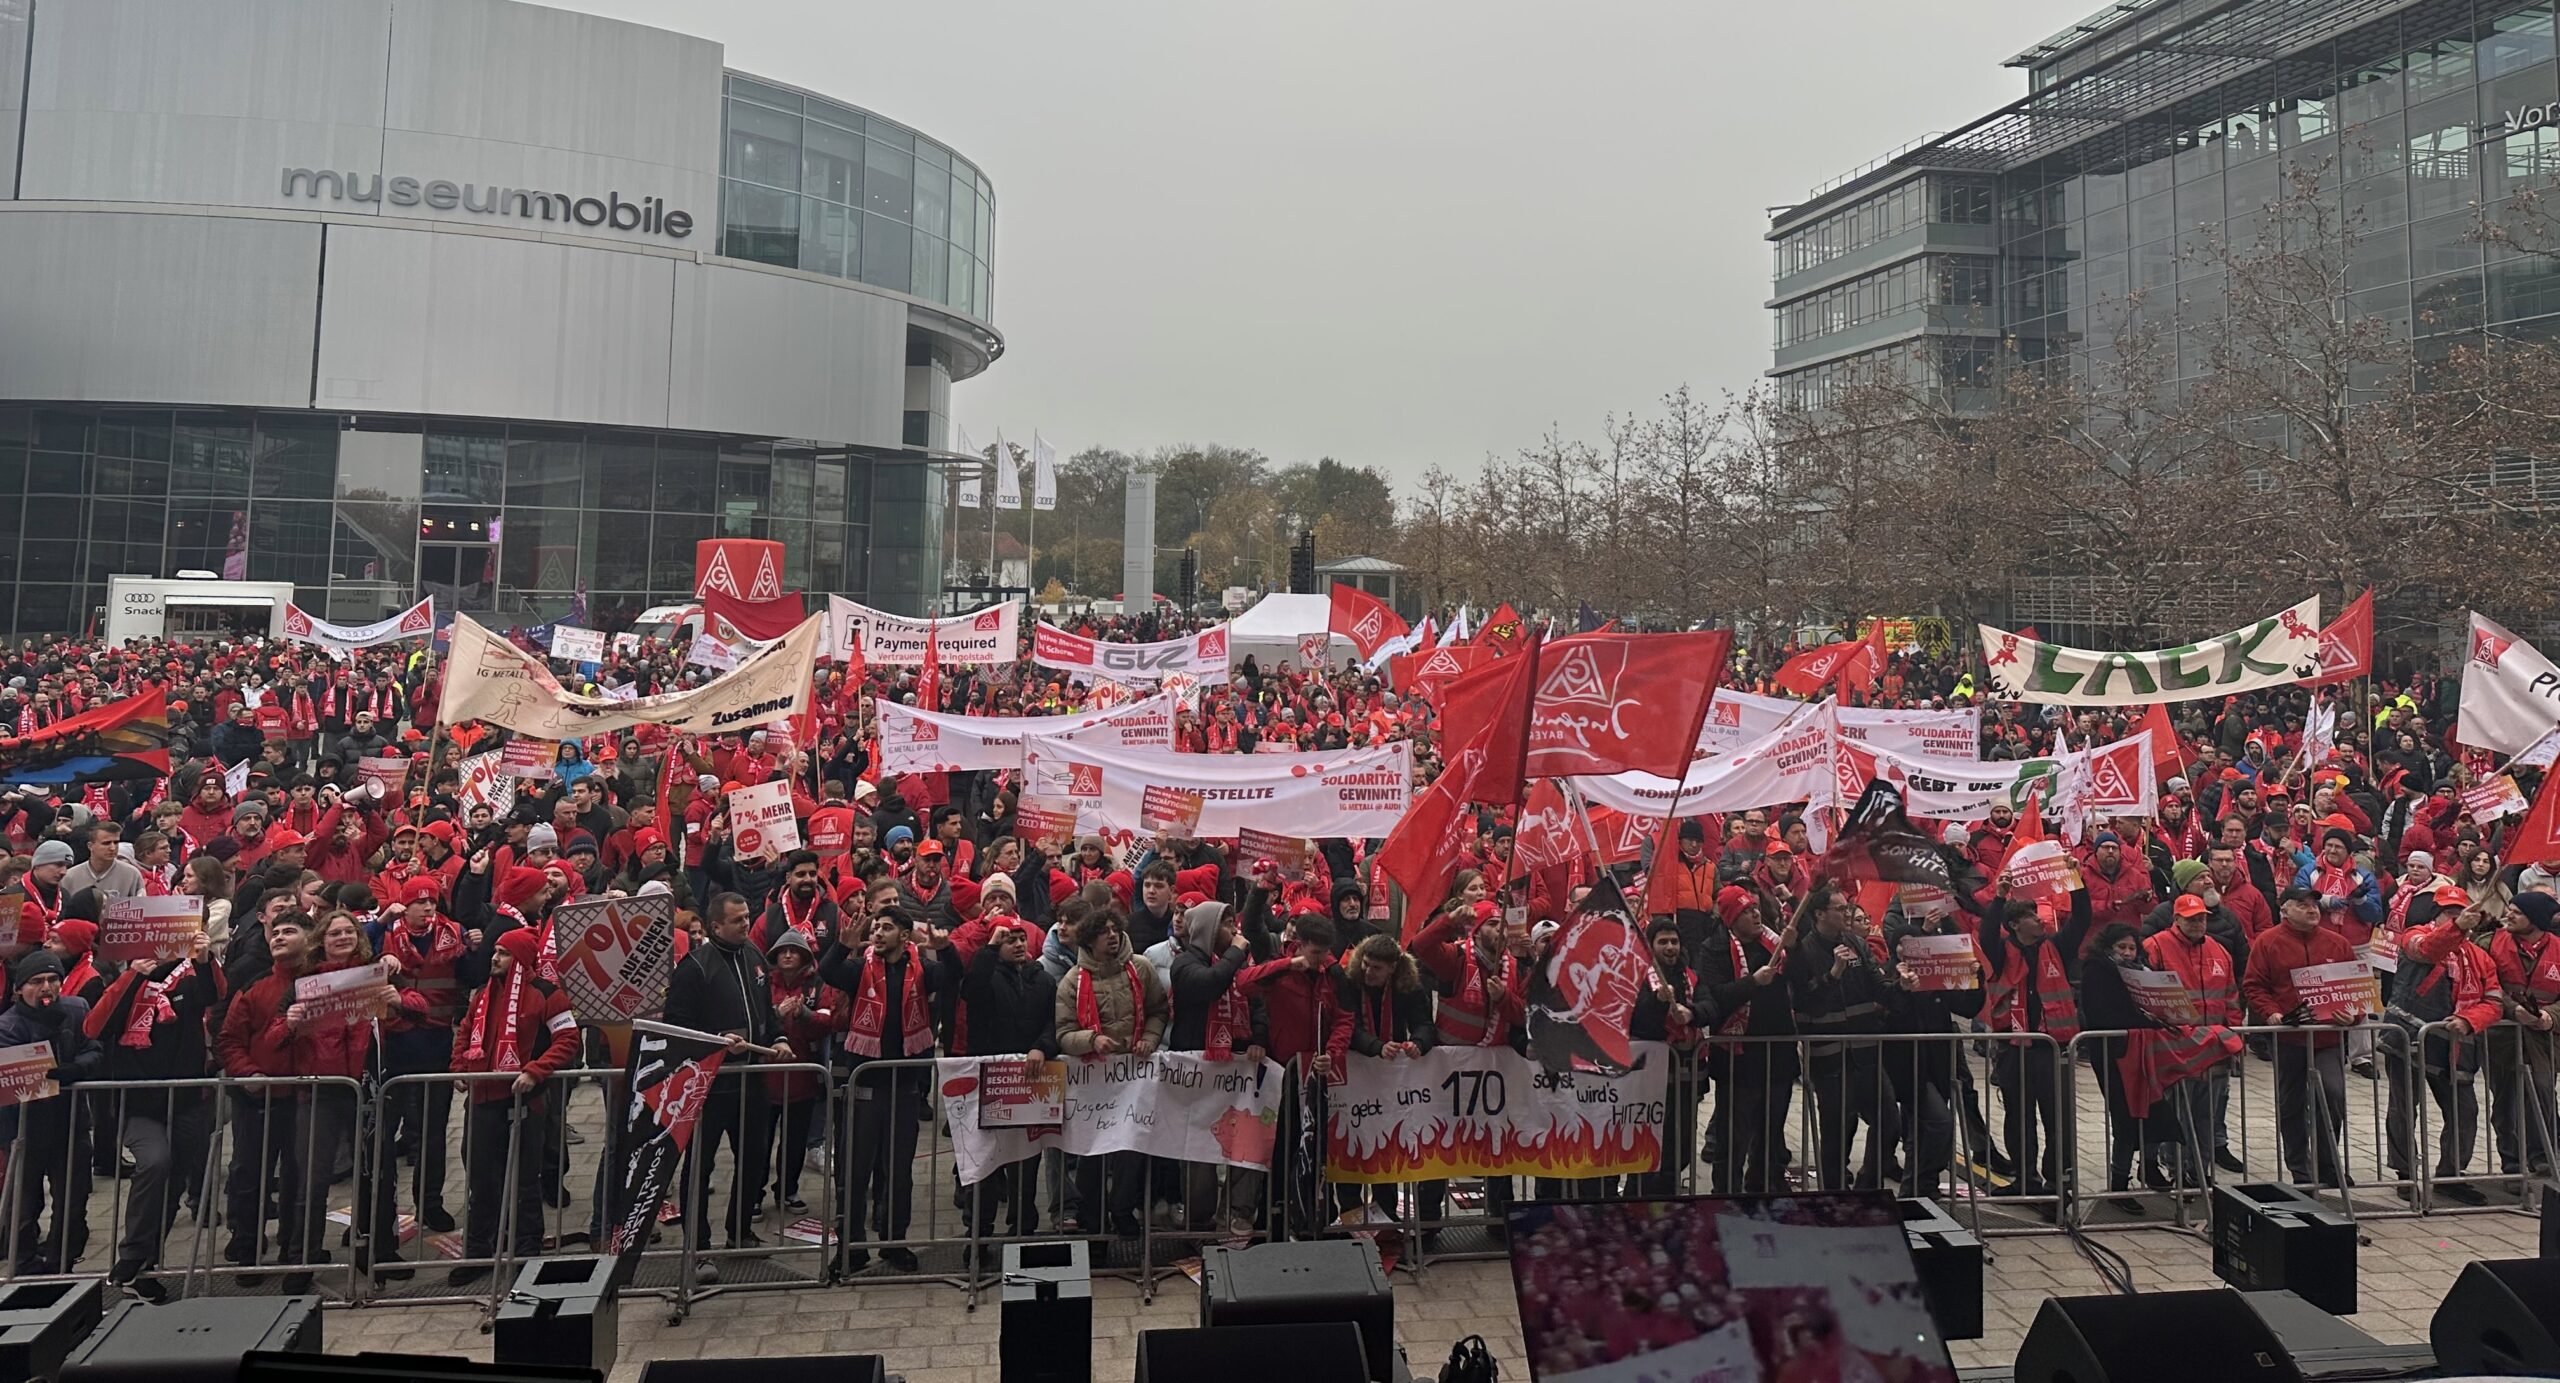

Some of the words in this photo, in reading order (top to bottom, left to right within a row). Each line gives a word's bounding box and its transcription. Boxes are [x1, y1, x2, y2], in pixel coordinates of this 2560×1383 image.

[124, 606, 163, 615] Snack
[876, 620, 913, 632] HTTP
[874, 637, 928, 652] Paymen
[938, 637, 997, 652] required
[949, 652, 994, 662] Ingolstadt
[1102, 645, 1189, 671] GVZ
[2023, 617, 2289, 696] LACK
[477, 667, 489, 678] IG
[492, 670, 525, 680] METALL
[1107, 714, 1168, 728] SOLIDARITÄT
[1121, 728, 1168, 738] GEWINNT!
[1726, 728, 1740, 736] AUDI
[1908, 726, 1974, 740] SOLIDARITÄT
[1923, 739, 1973, 751] GEWINNT!
[1320, 770, 1402, 786] SOLIDARITÄT
[1907, 774, 1957, 792] GEBT
[1967, 782, 2003, 791] UNS
[492, 776, 510, 801] STREIC
[1339, 788, 1402, 801] GEWINNT!
[1633, 785, 1704, 799] ROHBAU
[761, 802, 792, 821] MEHR
[1143, 802, 1177, 816] SICHERUNG
[1040, 821, 1072, 832] Ringen!
[106, 922, 133, 930] Hände
[557, 902, 652, 994] 7%
[618, 953, 639, 982] AUF
[635, 916, 668, 955] EINEN
[629, 937, 672, 988] STREICH
[2331, 989, 2376, 1002] Ringen!
[1104, 1056, 1154, 1083] wollen
[1159, 1062, 1203, 1088] endlich
[986, 1086, 1032, 1096] SICHERUNG
[1350, 1098, 1383, 1128] gebt
[1397, 1086, 1431, 1106] uns
[1441, 1070, 1506, 1117] 170
[1576, 1081, 1619, 1105] wird's
[1612, 1100, 1664, 1127] HITZIG
[1096, 1116, 1118, 1130] bei
